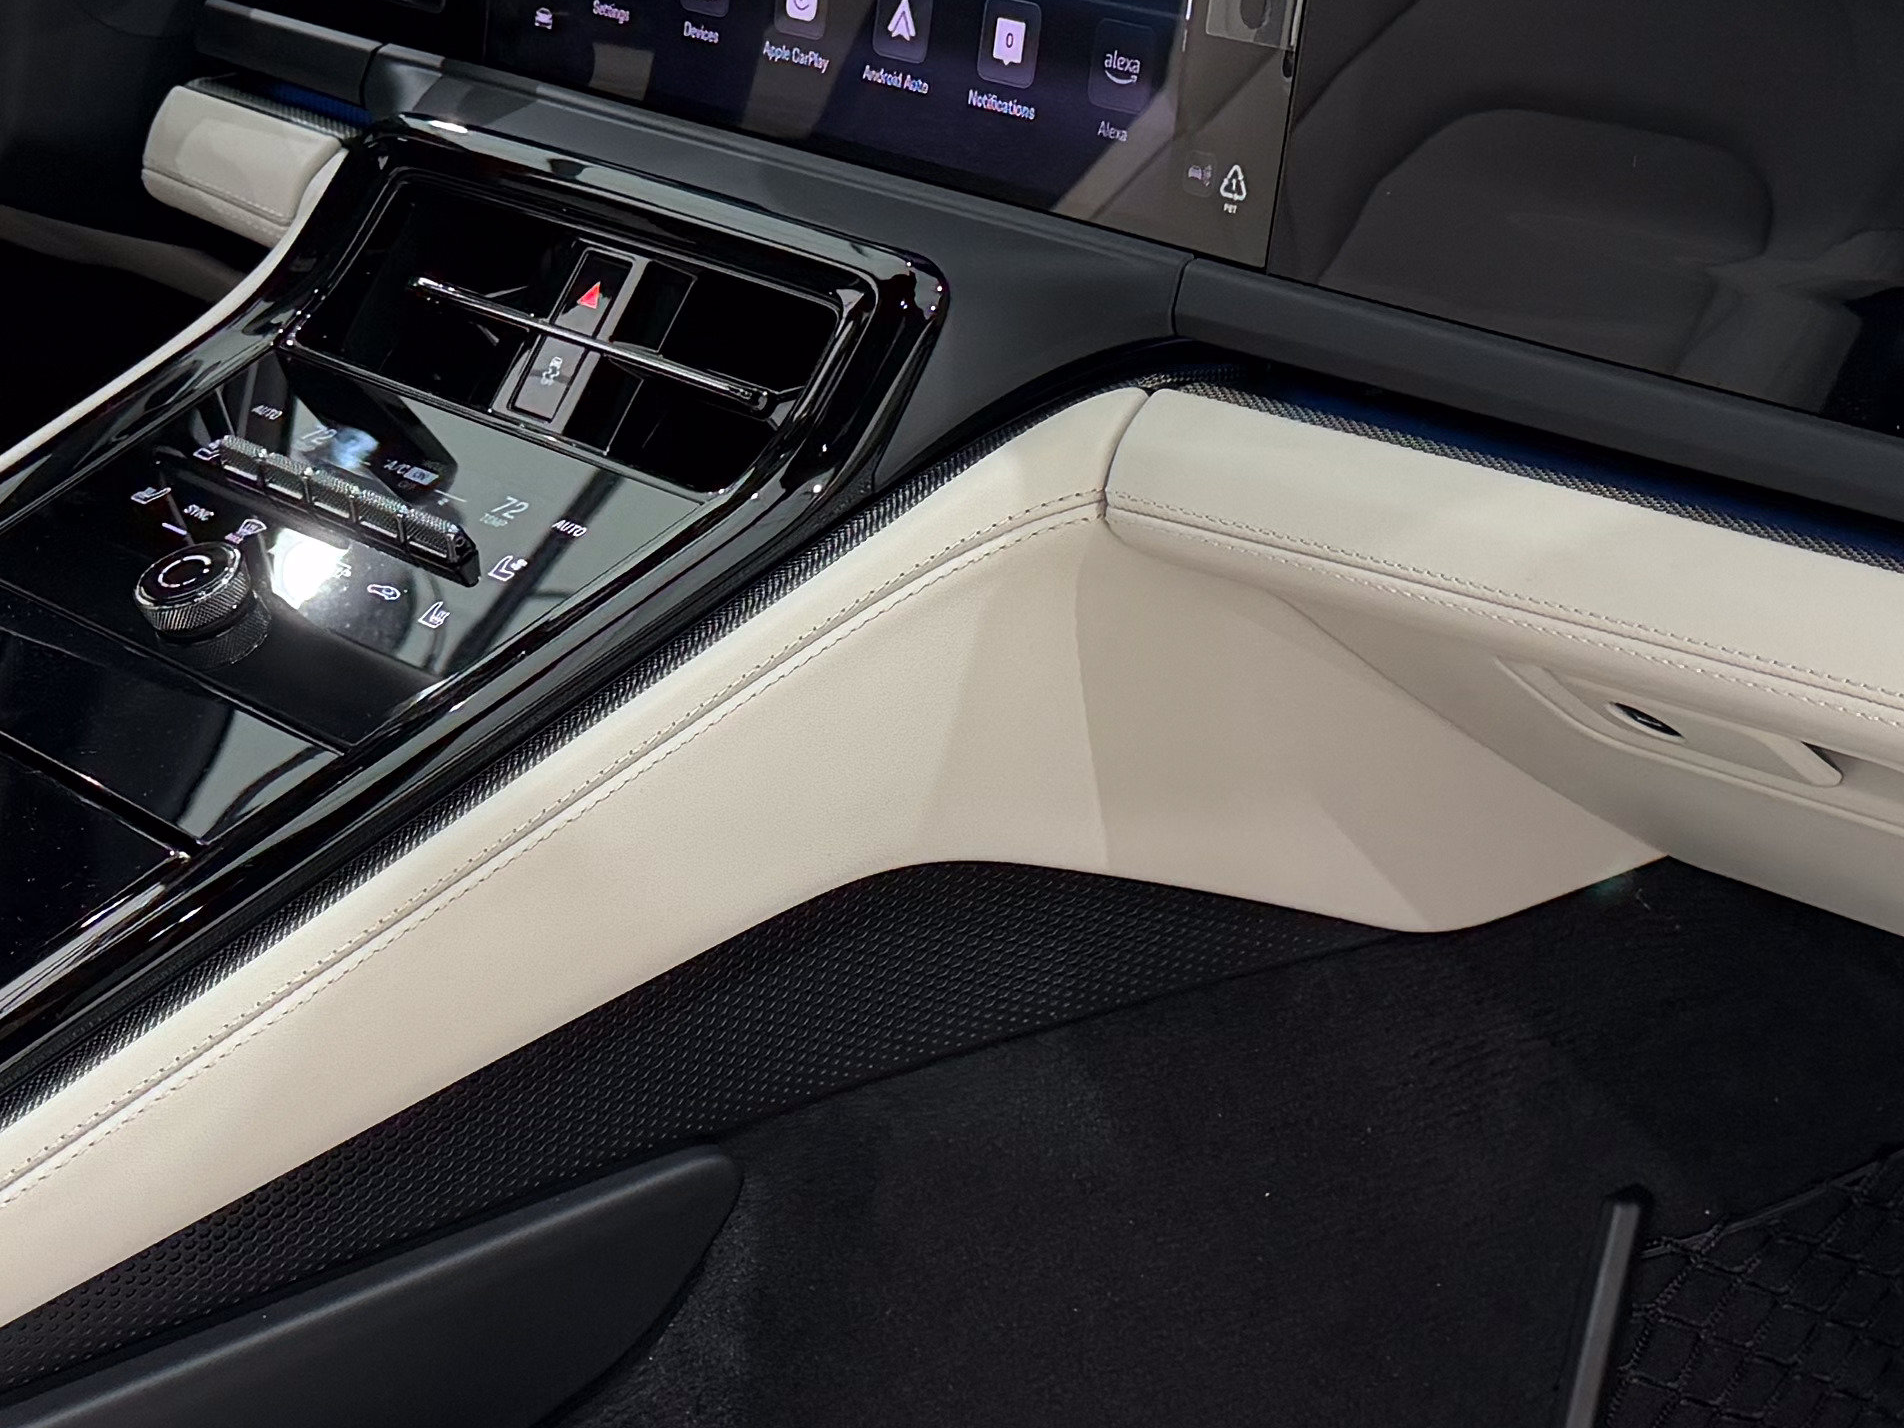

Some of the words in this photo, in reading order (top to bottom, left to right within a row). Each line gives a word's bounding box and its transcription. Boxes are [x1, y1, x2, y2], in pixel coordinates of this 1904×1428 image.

[593, 0, 630, 24] Settings
[684, 21, 719, 44] Devices
[1005, 32, 1014, 48] 0
[763, 41, 790, 63] Apple
[792, 47, 830, 73] CarPlay
[1104, 50, 1141, 74] alexa
[862, 65, 902, 89] Android
[903, 73, 929, 94] Auto
[968, 89, 1035, 120] Notifications
[1097, 121, 1128, 142] Alexa
[300, 427, 338, 445] 72
[184, 503, 214, 521] SYNC
[491, 496, 529, 519] 72
[551, 519, 588, 538] AUTO
